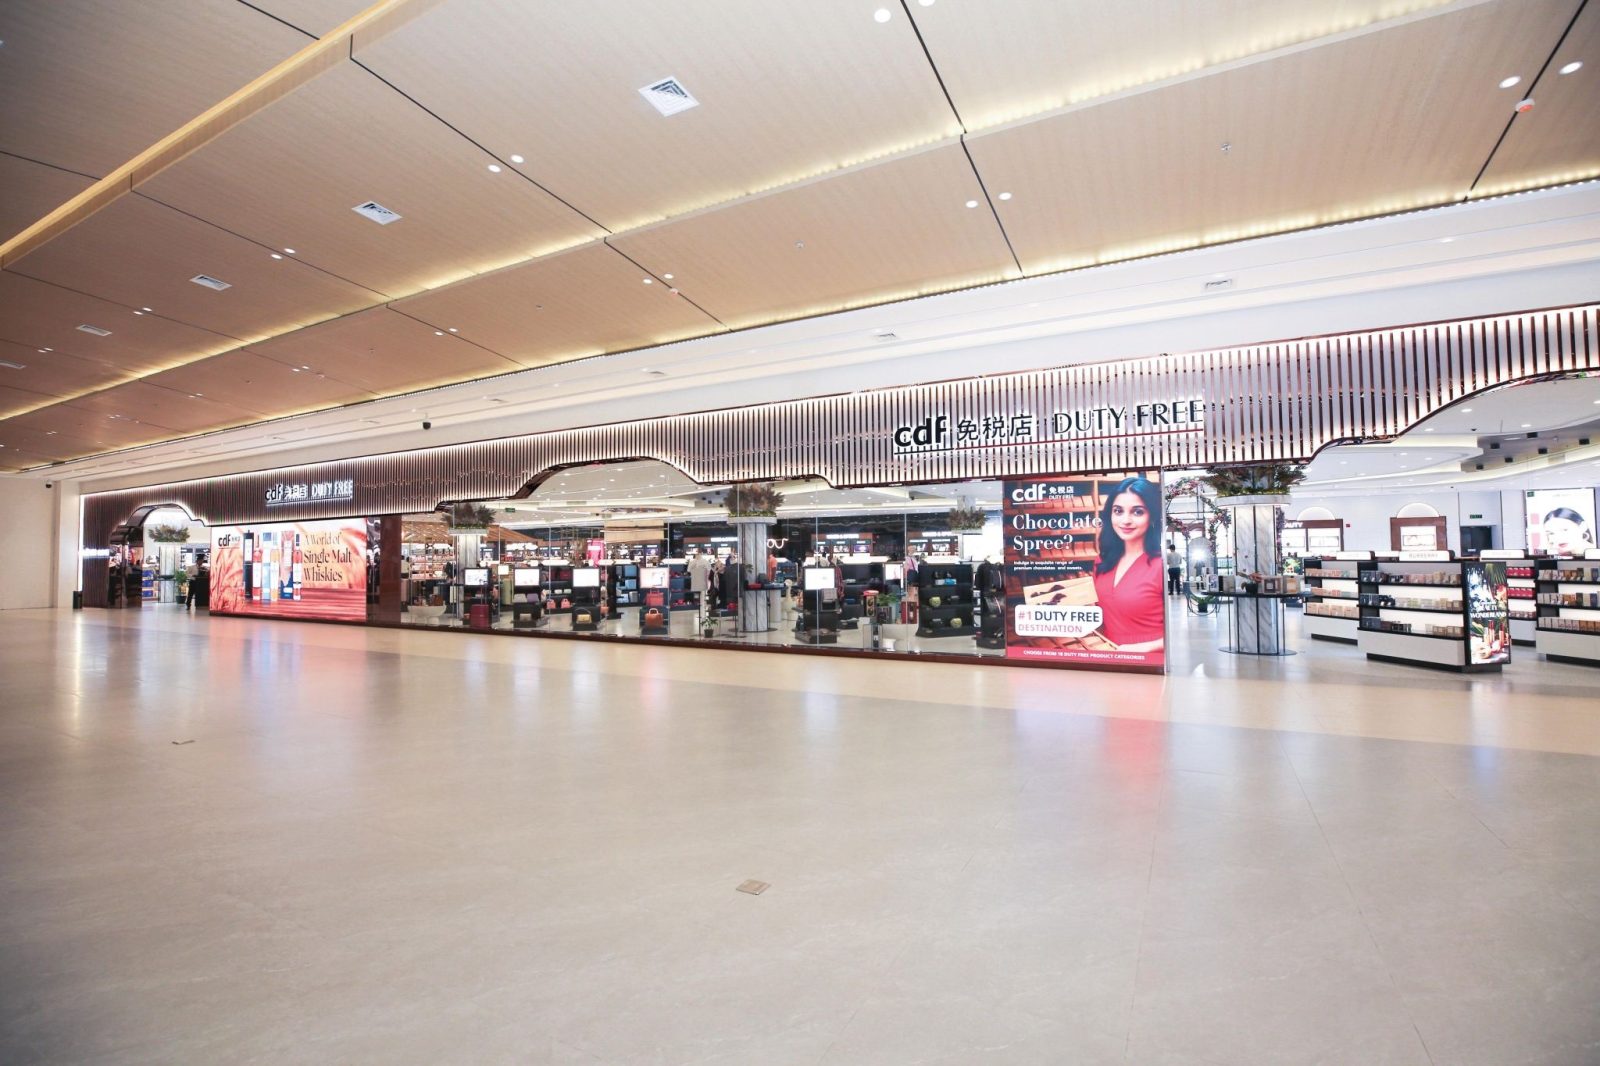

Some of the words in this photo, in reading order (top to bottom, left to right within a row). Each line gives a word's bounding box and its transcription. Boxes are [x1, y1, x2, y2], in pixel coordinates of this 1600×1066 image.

[894, 415, 947, 447] cdf
[957, 413, 1033, 441] 免税店
[1054, 404, 1125, 434] DUTY
[1136, 400, 1204, 427] FREE
[265, 484, 283, 501] cdf
[312, 483, 332, 497] DUTY
[334, 480, 353, 495] FREE
[1012, 484, 1047, 501] cdf
[1012, 512, 1103, 530] Chocolate
[218, 534, 231, 548] cdf
[1013, 534, 1073, 556] Spree?
[303, 549, 330, 567] Single
[332, 548, 352, 563] Malt
[304, 567, 342, 582] Whiskies
[1018, 611, 1032, 620] #1
[1034, 611, 1068, 621] DUTY
[1070, 612, 1100, 622] FREE
[1018, 624, 1082, 633] DESTINATION
